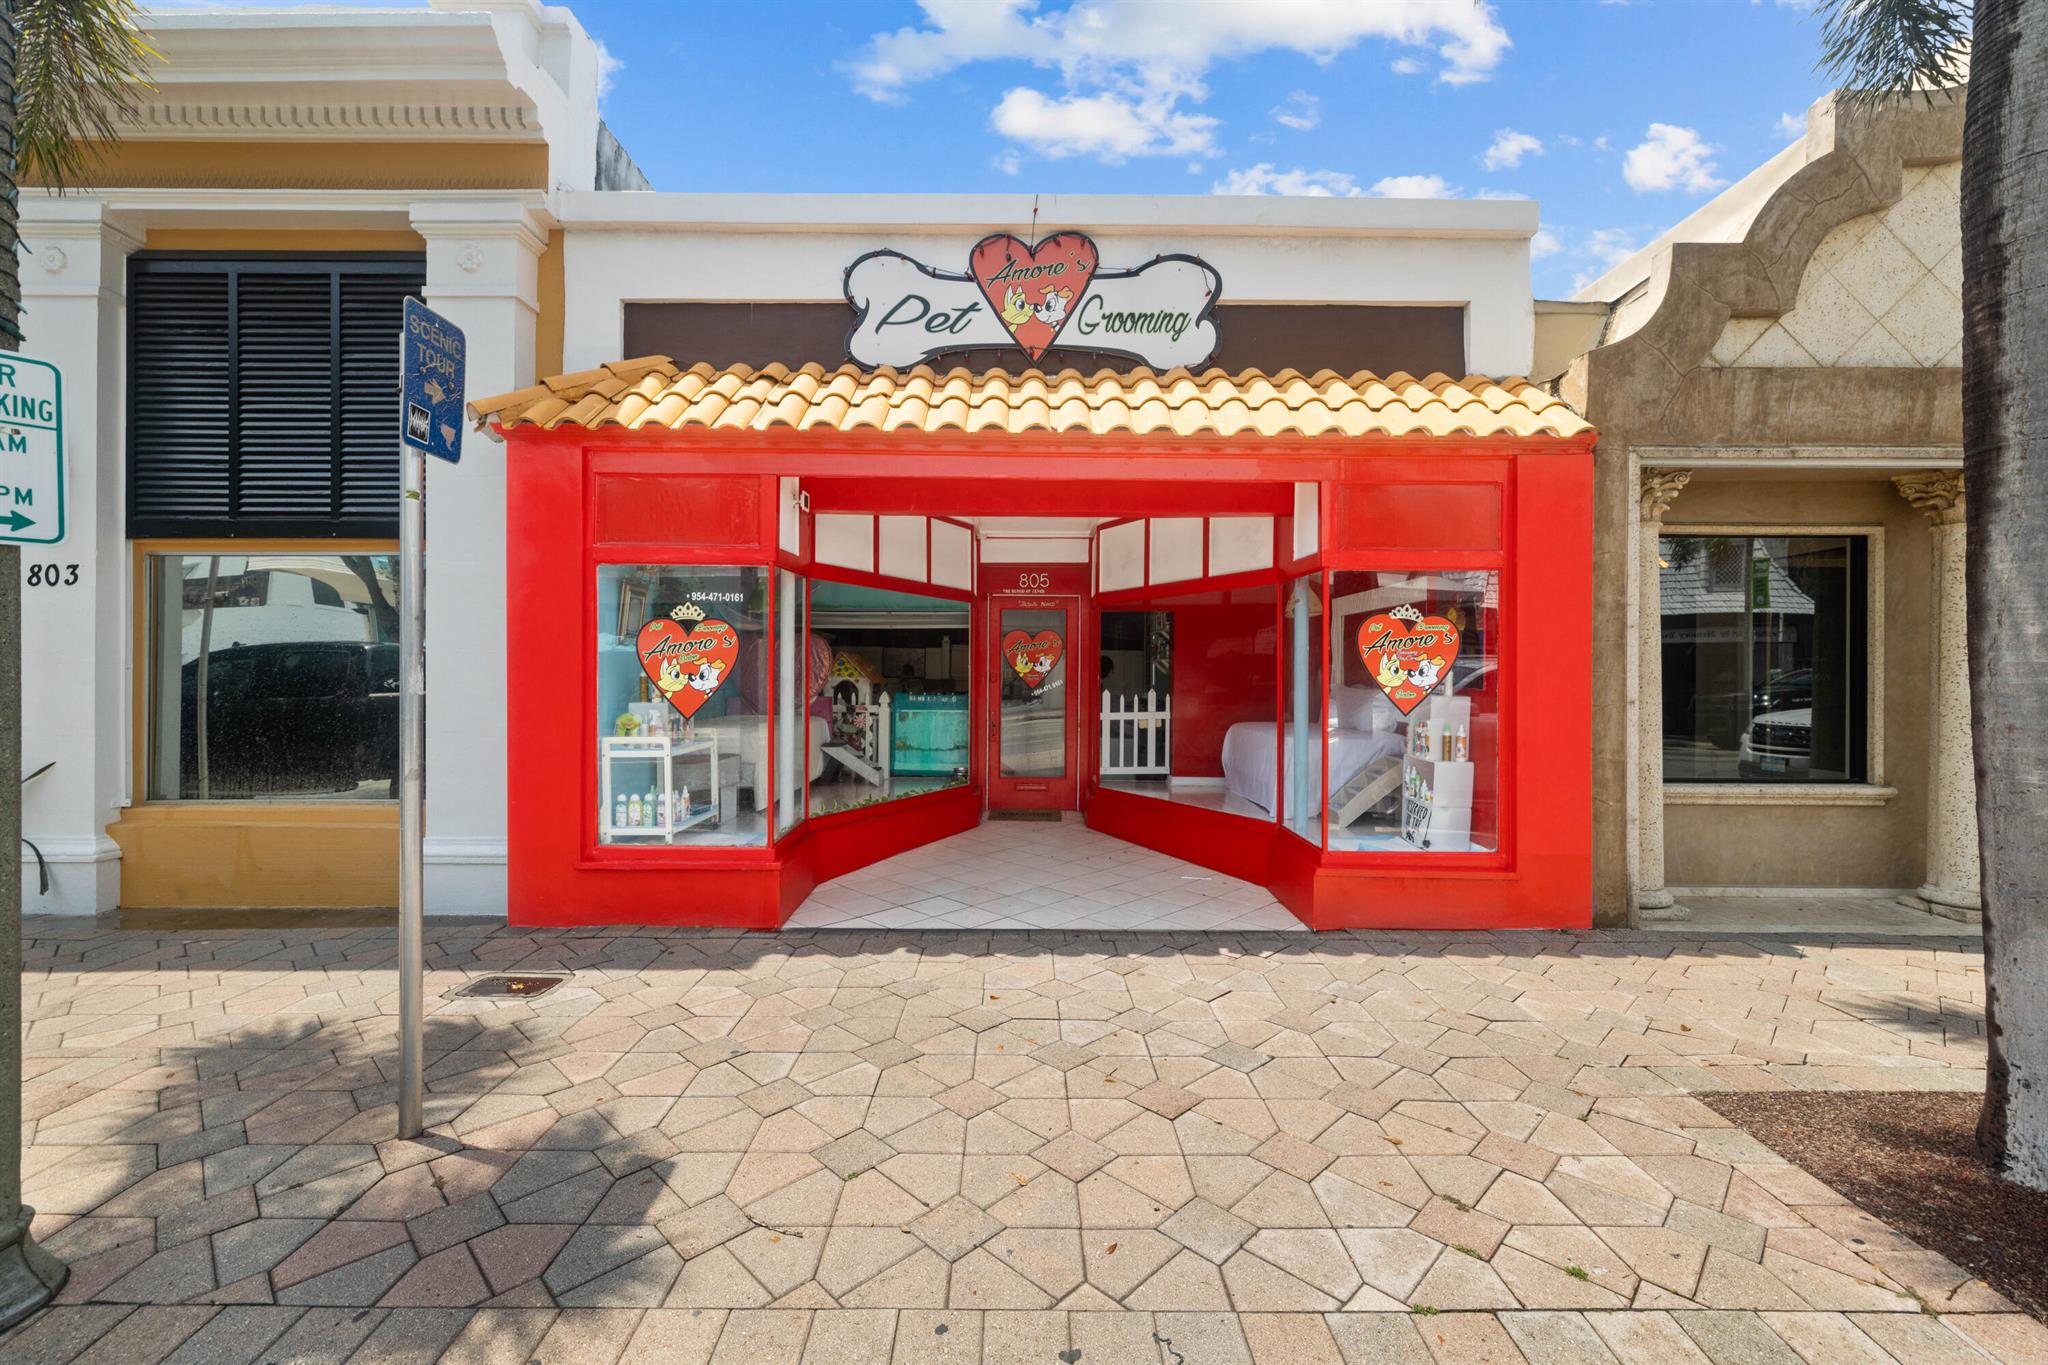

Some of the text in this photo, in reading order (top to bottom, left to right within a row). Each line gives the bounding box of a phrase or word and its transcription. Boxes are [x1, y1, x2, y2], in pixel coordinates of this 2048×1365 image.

[875, 294, 1191, 342] Pet Grooming
[409, 314, 463, 360] SCENIC
[417, 341, 455, 379] TOUR
[27, 563, 80, 587] 803
[1019, 573, 1050, 588] 805
[691, 592, 744, 602] 954-471-0161
